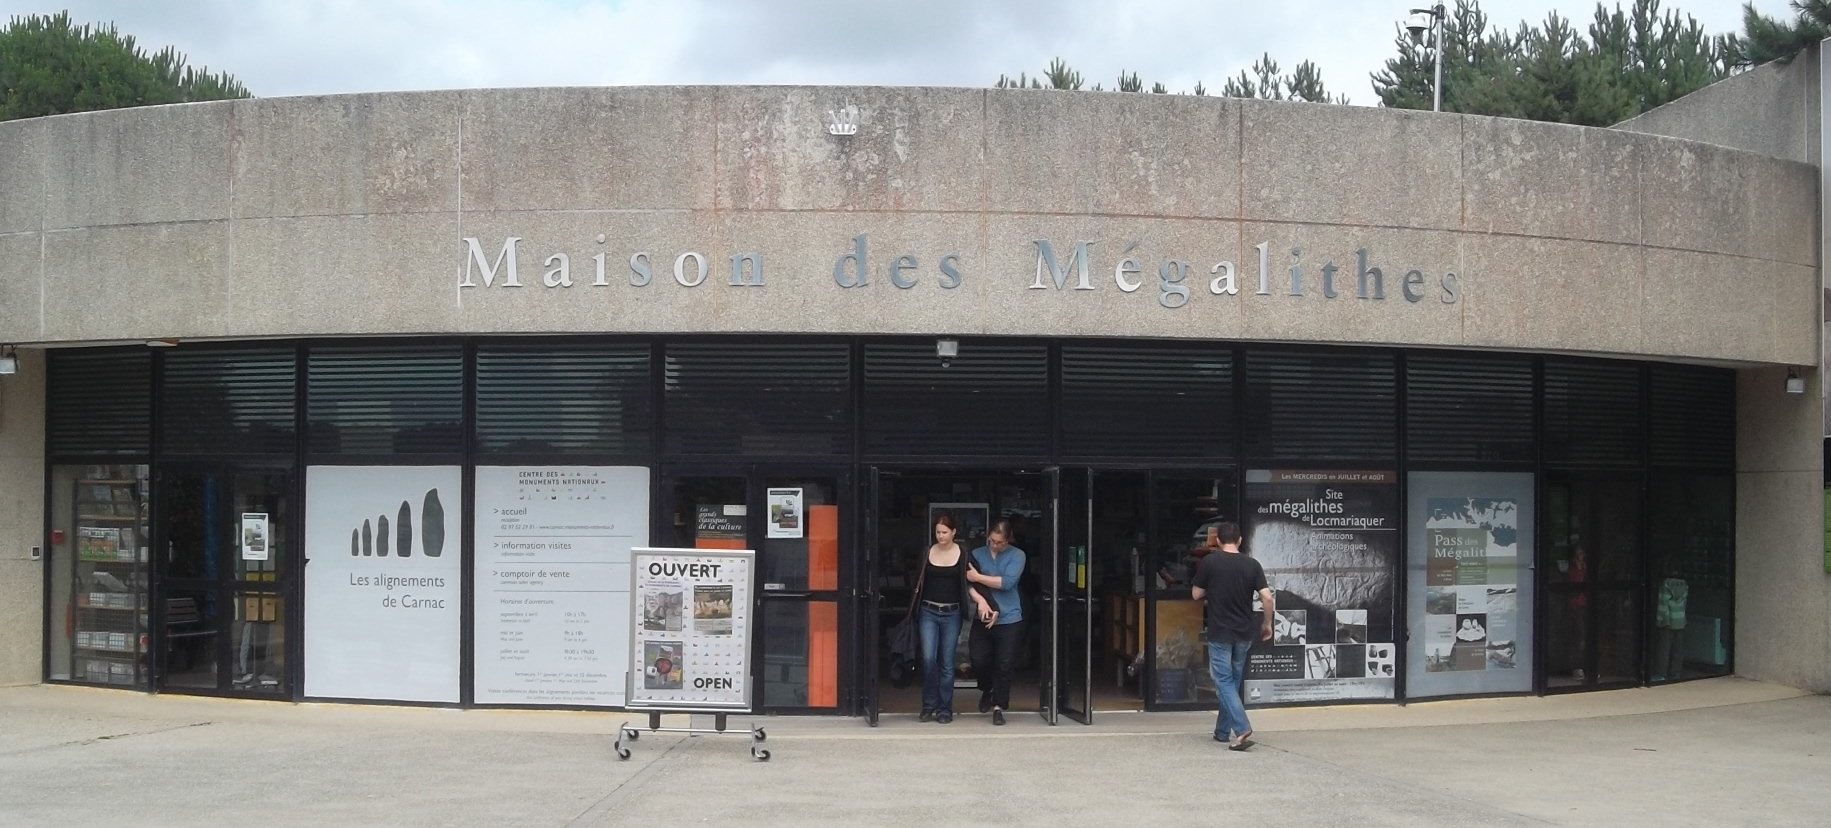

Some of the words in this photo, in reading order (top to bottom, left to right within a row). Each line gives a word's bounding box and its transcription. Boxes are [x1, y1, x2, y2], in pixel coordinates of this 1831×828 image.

[460, 233, 766, 288] Maison
[832, 232, 963, 290] des
[1029, 237, 1461, 309] Mégalithes
[1325, 489, 1344, 500] Site
[501, 508, 527, 516] accueil
[1257, 505, 1269, 514] des
[1269, 498, 1344, 518] mégalithes
[698, 522, 707, 530] de
[716, 522, 742, 530] culture
[1310, 514, 1385, 529] Locmariaquer
[501, 542, 546, 550] information
[548, 542, 572, 550] visites
[1435, 535, 1463, 546] Pass
[500, 571, 535, 580] comptoir
[649, 563, 721, 578] OUVERT
[350, 572, 370, 586] Les
[373, 574, 445, 590] alignements
[382, 594, 397, 608] de
[401, 594, 445, 609] Carnac
[694, 678, 732, 688] OPEN
